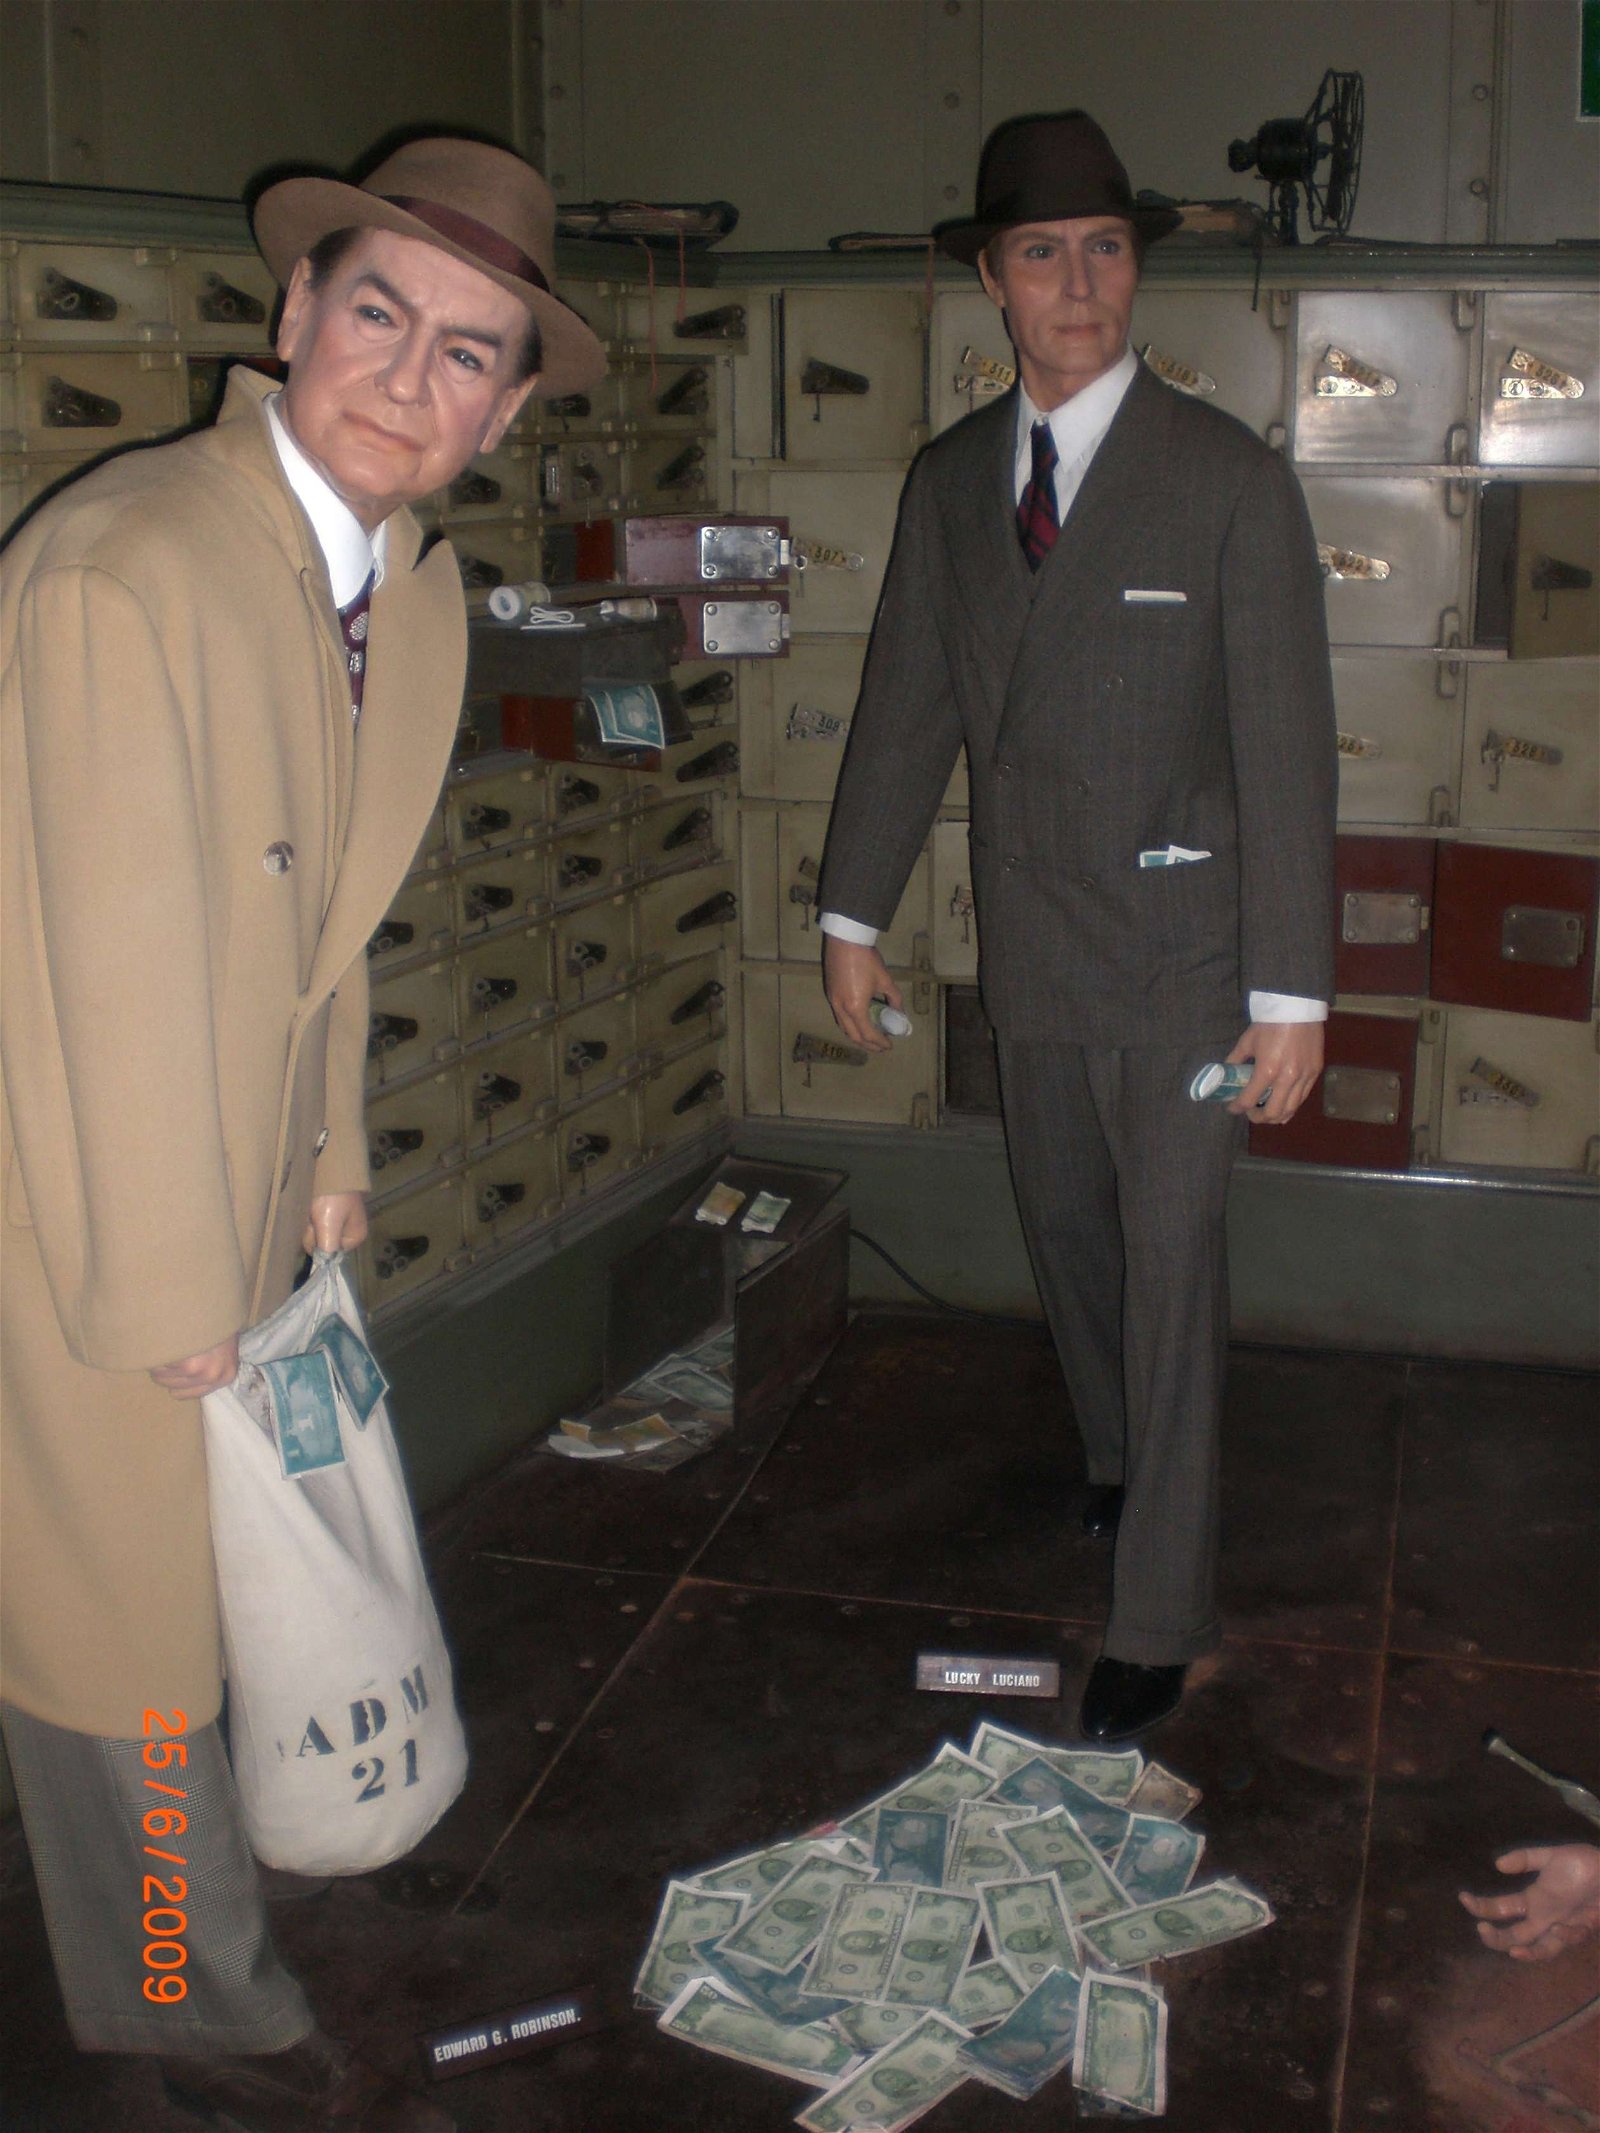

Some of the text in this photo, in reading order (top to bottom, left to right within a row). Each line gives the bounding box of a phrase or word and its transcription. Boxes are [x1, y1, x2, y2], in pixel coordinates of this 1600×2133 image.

[945, 1671, 1041, 1687] LUCKY LUCIANO
[351, 1738, 420, 1803] 21
[433, 2008, 582, 2063] EDWARD G. ROBINSON.
